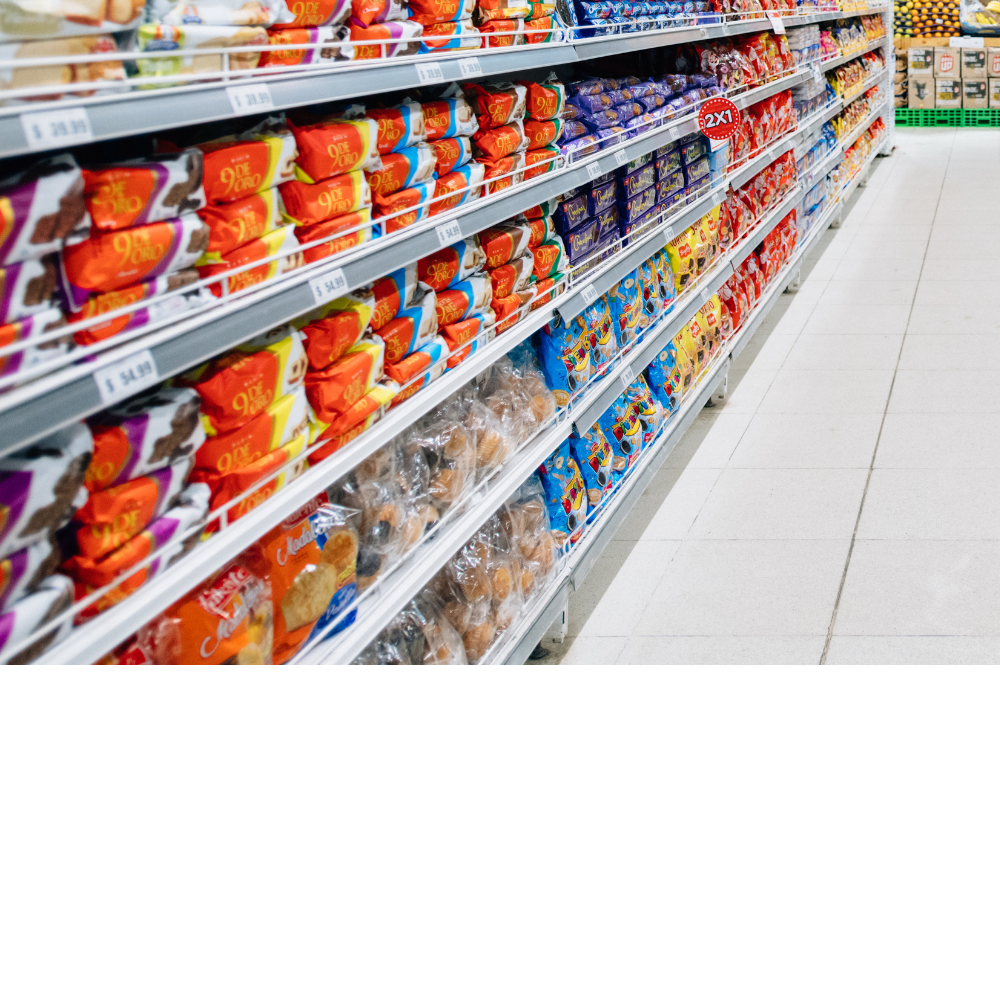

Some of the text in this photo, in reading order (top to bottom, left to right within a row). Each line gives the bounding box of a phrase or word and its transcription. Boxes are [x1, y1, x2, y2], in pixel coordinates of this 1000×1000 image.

[293, 2, 319, 25] 9 DE
[442, 3, 456, 14] ORO
[300, 14, 324, 26] ORO
[537, 97, 554, 111] 9 DE
[543, 106, 556, 116] ORO
[427, 108, 439, 118] DE
[704, 110, 733, 128] 2X1
[429, 117, 448, 128] ORO
[503, 143, 517, 153] ORO
[504, 136, 512, 145] DE
[328, 142, 350, 168] 9 DE
[338, 152, 359, 167] ORO
[220, 162, 250, 195] 9 DE
[234, 173, 262, 192] ORO
[381, 171, 393, 183] DE
[378, 180, 400, 195] ORO
[318, 188, 343, 216] 9 DE
[332, 199, 351, 214] ORO
[447, 226, 460, 237] 54.99
[113, 230, 149, 267] 9 DE
[131, 244, 164, 264] ORO
[435, 263, 448, 274] DE
[437, 270, 455, 282] ORO
[325, 277, 344, 293] 54.99
[381, 304, 390, 316] DE
[381, 309, 397, 326] ORO
[105, 360, 153, 394] $ 54.99
[232, 382, 263, 416] 9 DE
